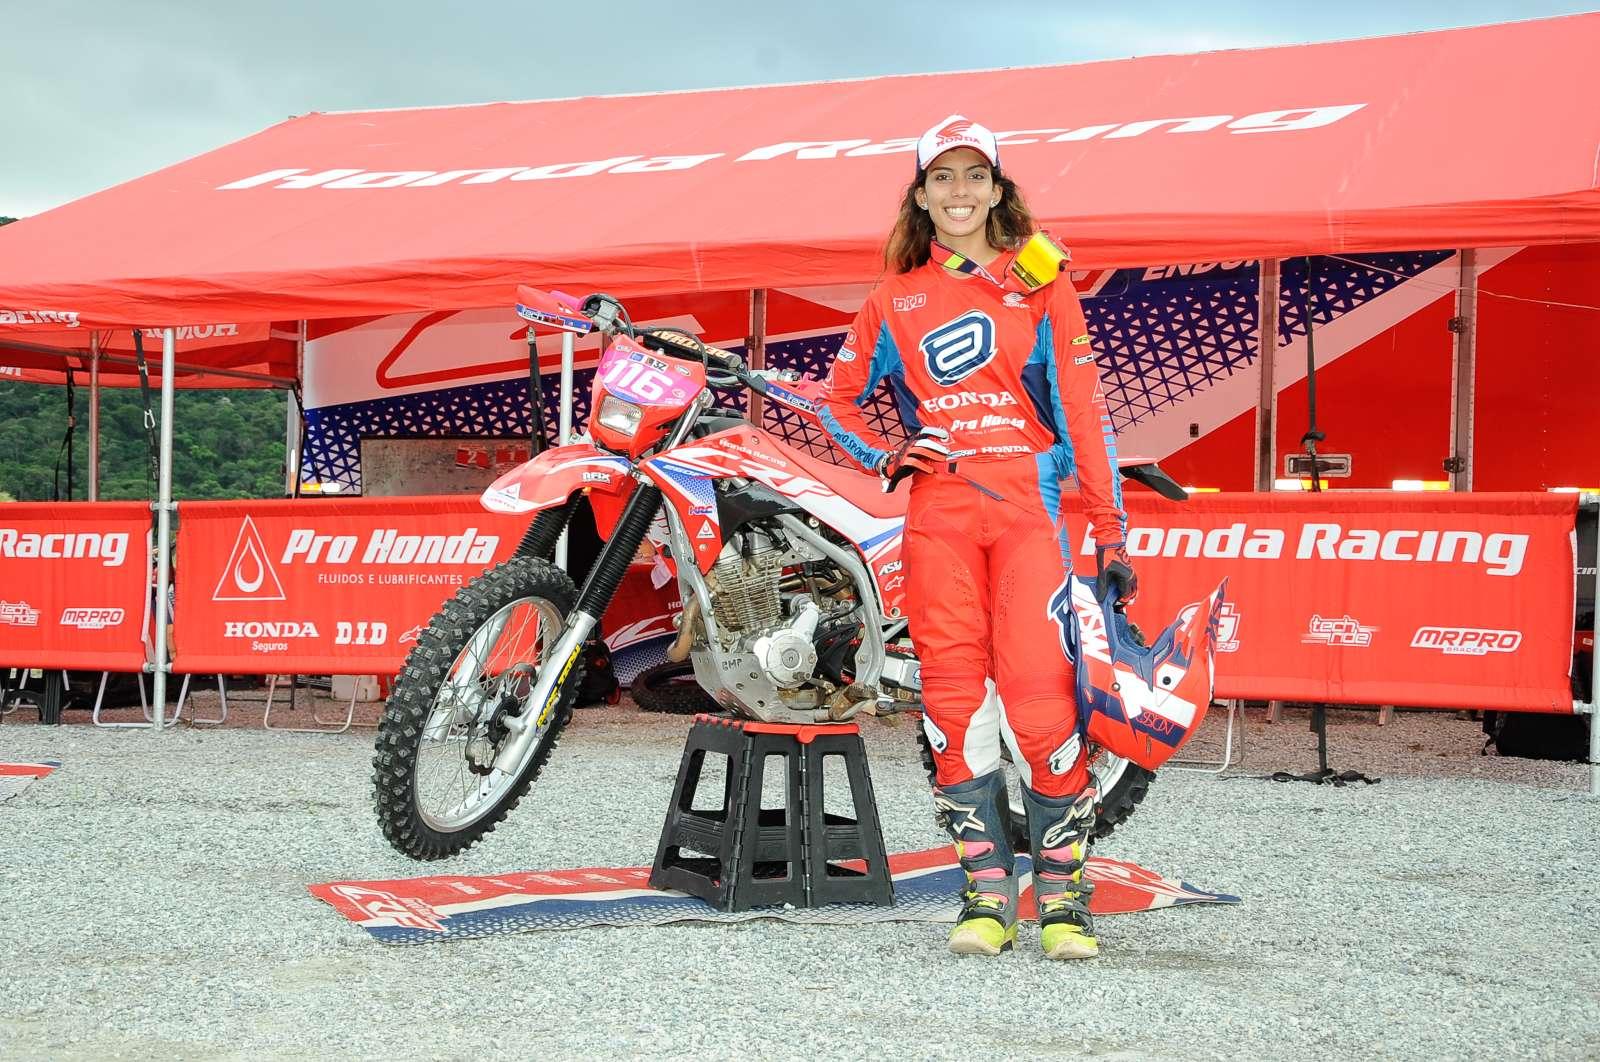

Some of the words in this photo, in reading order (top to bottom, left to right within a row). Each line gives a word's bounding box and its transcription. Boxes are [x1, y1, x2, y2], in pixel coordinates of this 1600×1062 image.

[936, 136, 981, 147] HONDA
[218, 153, 725, 190] Honda
[603, 359, 674, 401] 116
[921, 391, 1018, 413] HONDA
[950, 418, 978, 432] Pro
[981, 446, 1033, 454] HONDA
[0, 529, 129, 567] Racing
[281, 529, 358, 564] Pro
[361, 528, 500, 564] Honda
[1296, 523, 1531, 577] Racing
[318, 573, 364, 585] FLUIDOS
[368, 574, 375, 585] E
[378, 573, 463, 585] LUBRIFICANTES
[224, 621, 320, 638] HONDA
[335, 621, 388, 646] D.I.D
[252, 640, 289, 652] Seguros
